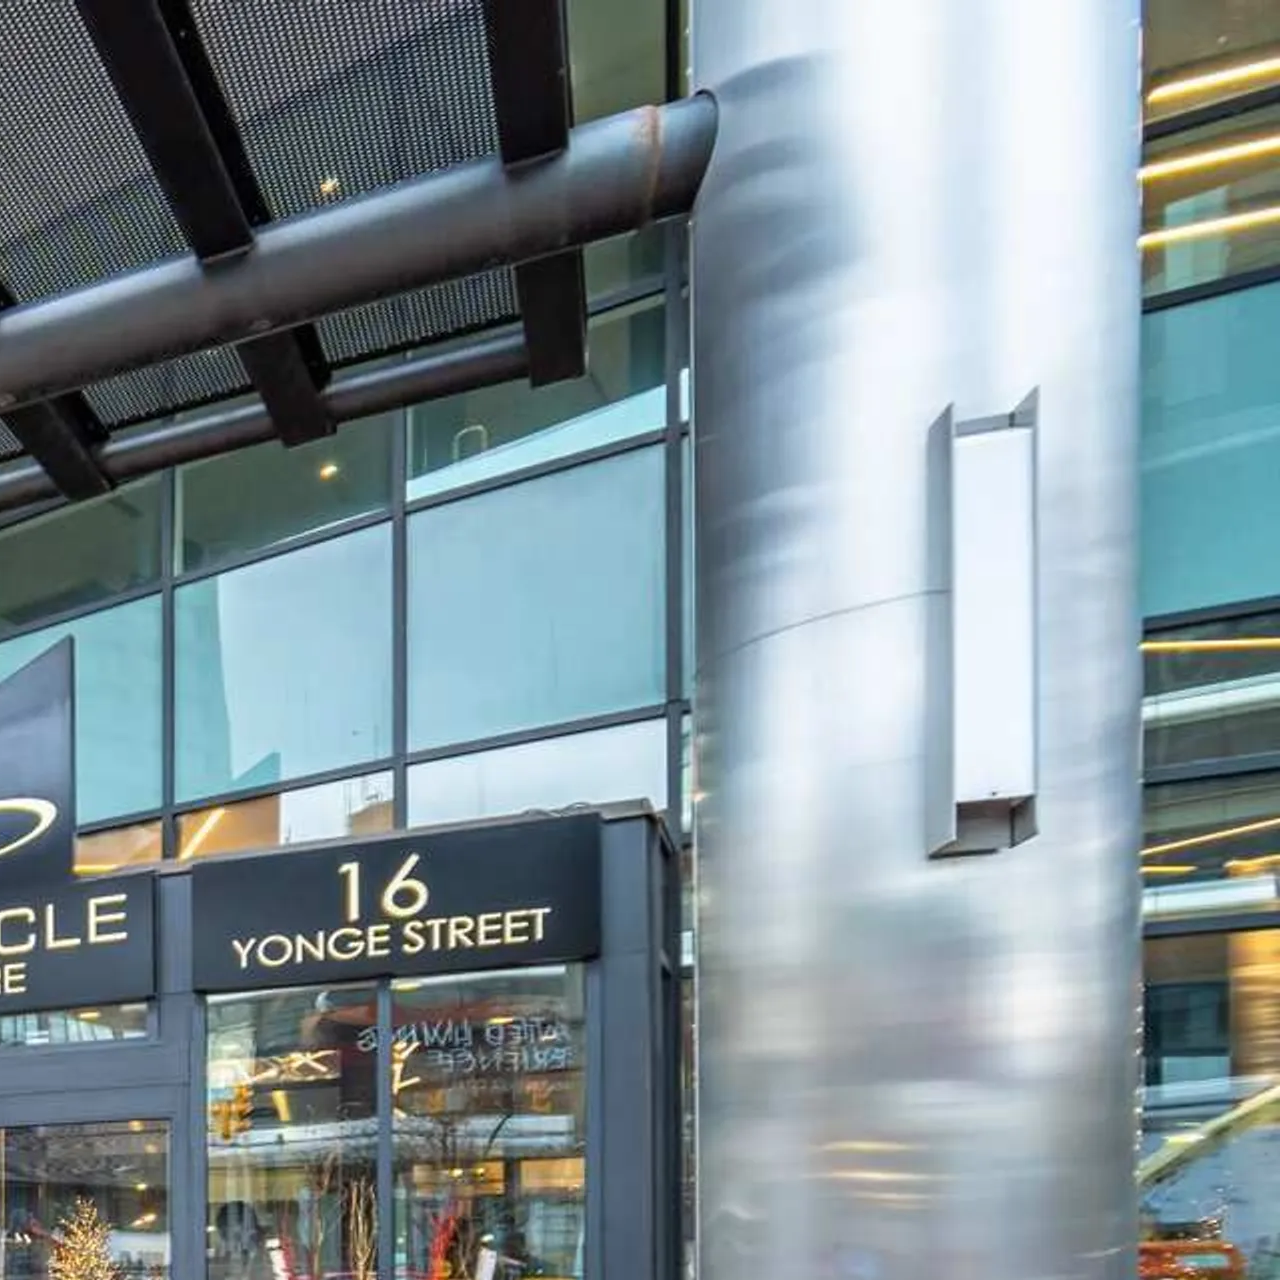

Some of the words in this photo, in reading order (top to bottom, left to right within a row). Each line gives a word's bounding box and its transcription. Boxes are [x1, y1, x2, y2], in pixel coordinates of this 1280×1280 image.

[338, 853, 429, 922] 16
[232, 924, 391, 969] YONGE
[402, 907, 552, 954] STREET
